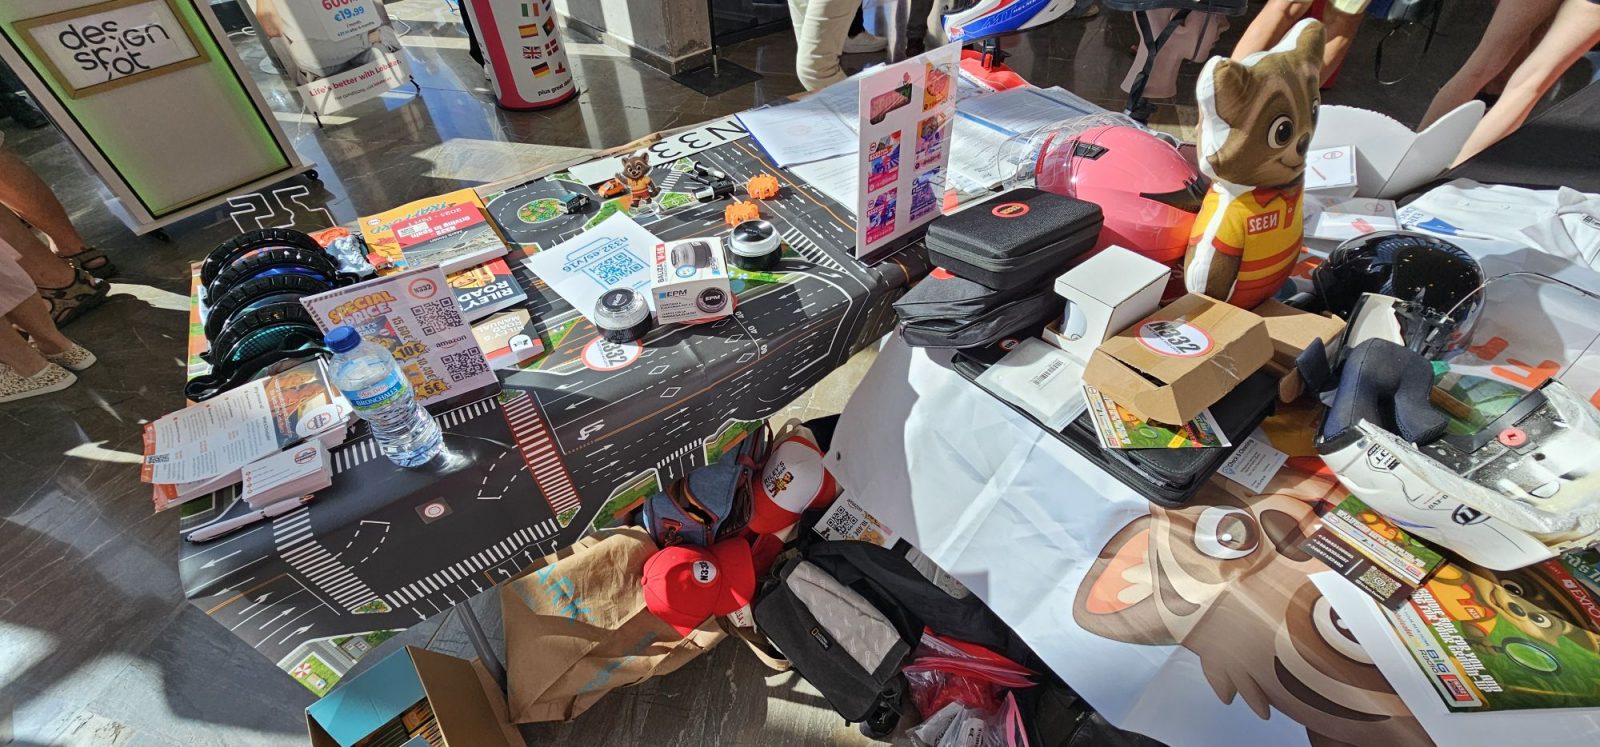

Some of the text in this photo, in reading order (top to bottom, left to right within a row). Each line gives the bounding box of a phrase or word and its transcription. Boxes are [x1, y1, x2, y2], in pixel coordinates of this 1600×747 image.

[334, 6, 364, 22] €19.99
[309, 86, 332, 97] Life's
[332, 76, 358, 90] better
[358, 70, 374, 80] with
[551, 84, 564, 93] great
[562, 236, 628, 272] n332.es/v16
[657, 264, 665, 283] BALIZA
[458, 280, 510, 302] ROAD
[667, 289, 687, 298] EPM
[328, 290, 397, 324] SPECIAL
[344, 302, 392, 326] PRICE
[476, 314, 519, 333] MANUAL
[748, 326, 758, 334] 40
[436, 335, 467, 348] amazon
[1149, 322, 1201, 354] N332
[399, 343, 421, 357] 10€
[356, 387, 398, 406] BRONCHALES
[424, 382, 442, 394] 5€
[1226, 455, 1238, 468] Check
[1238, 437, 1254, 455] Cleaning
[764, 461, 785, 484] RILEY'S
[846, 498, 863, 511] amazon
[1418, 587, 1443, 616] GOODIE
[1452, 633, 1470, 654] FOR
[1419, 602, 1438, 623] FOR
[1432, 620, 1453, 645] YOUR
